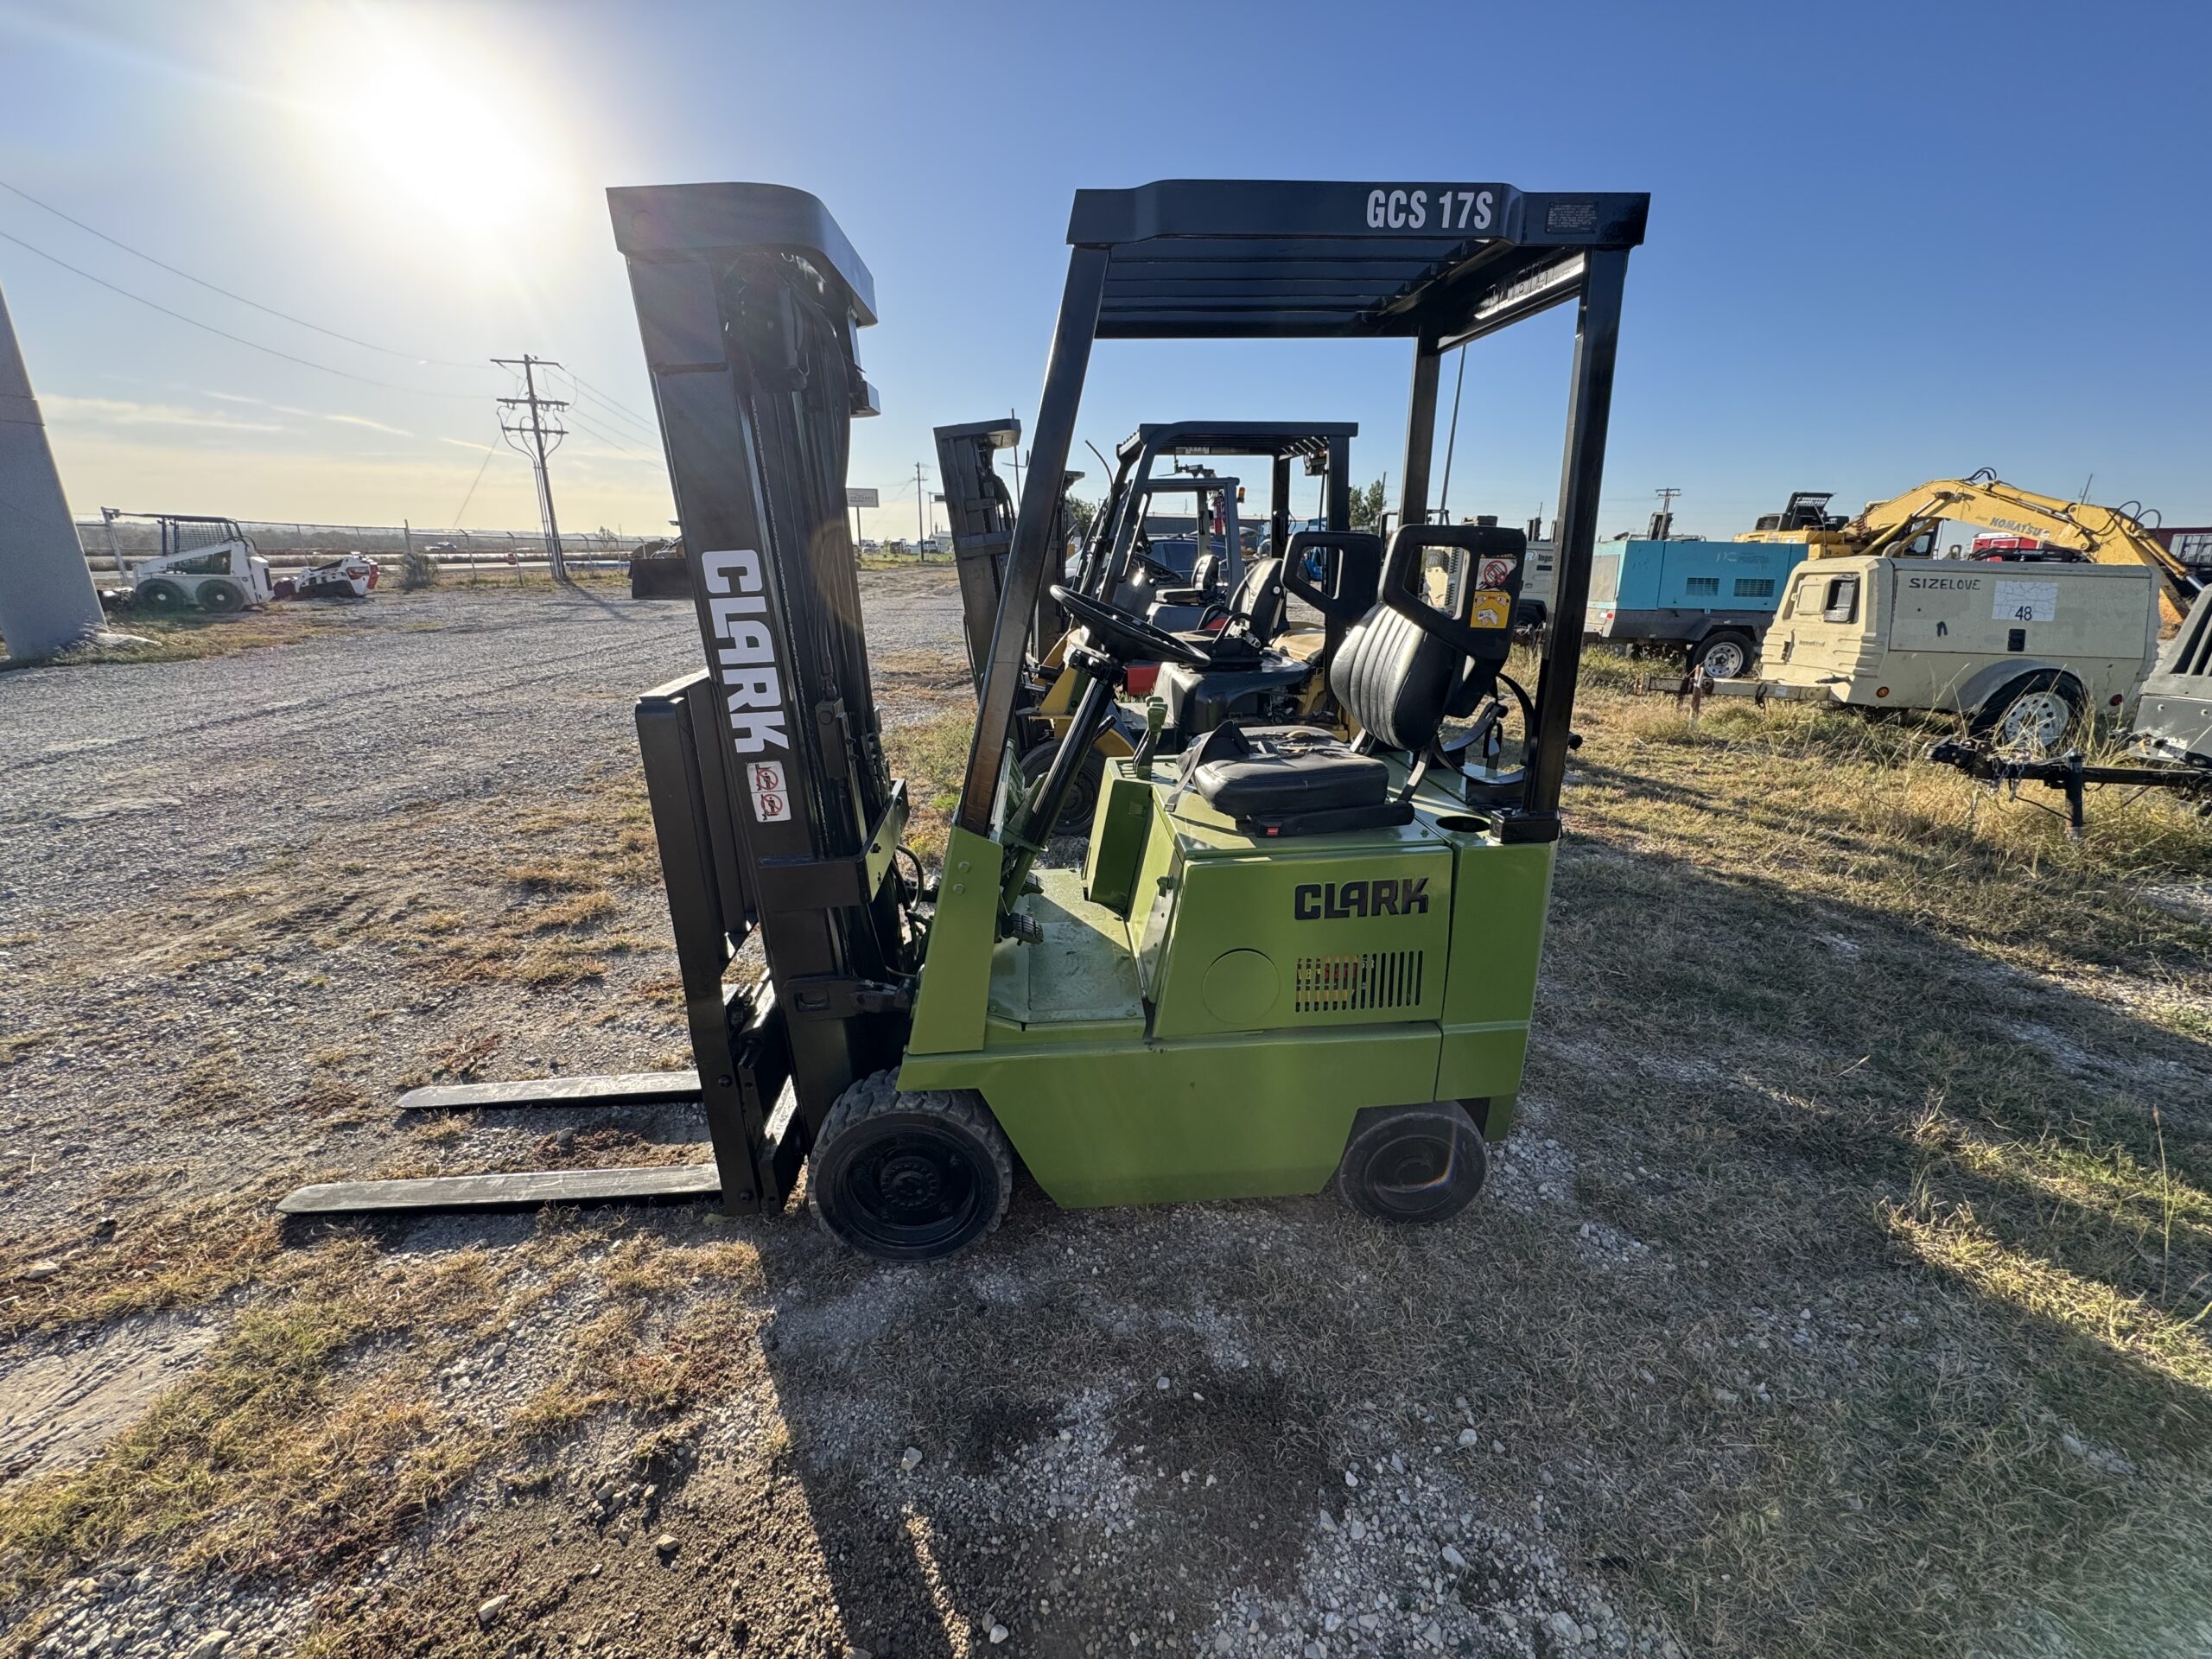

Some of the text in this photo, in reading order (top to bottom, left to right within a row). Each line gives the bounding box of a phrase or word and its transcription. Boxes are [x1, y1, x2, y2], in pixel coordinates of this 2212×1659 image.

[1366, 189, 1494, 230] GCS 17S
[1908, 578, 1981, 590] SIZELOVE
[2014, 606, 2033, 621] 48
[702, 550, 790, 753] CLARK
[1294, 877, 1429, 920] CLARK
